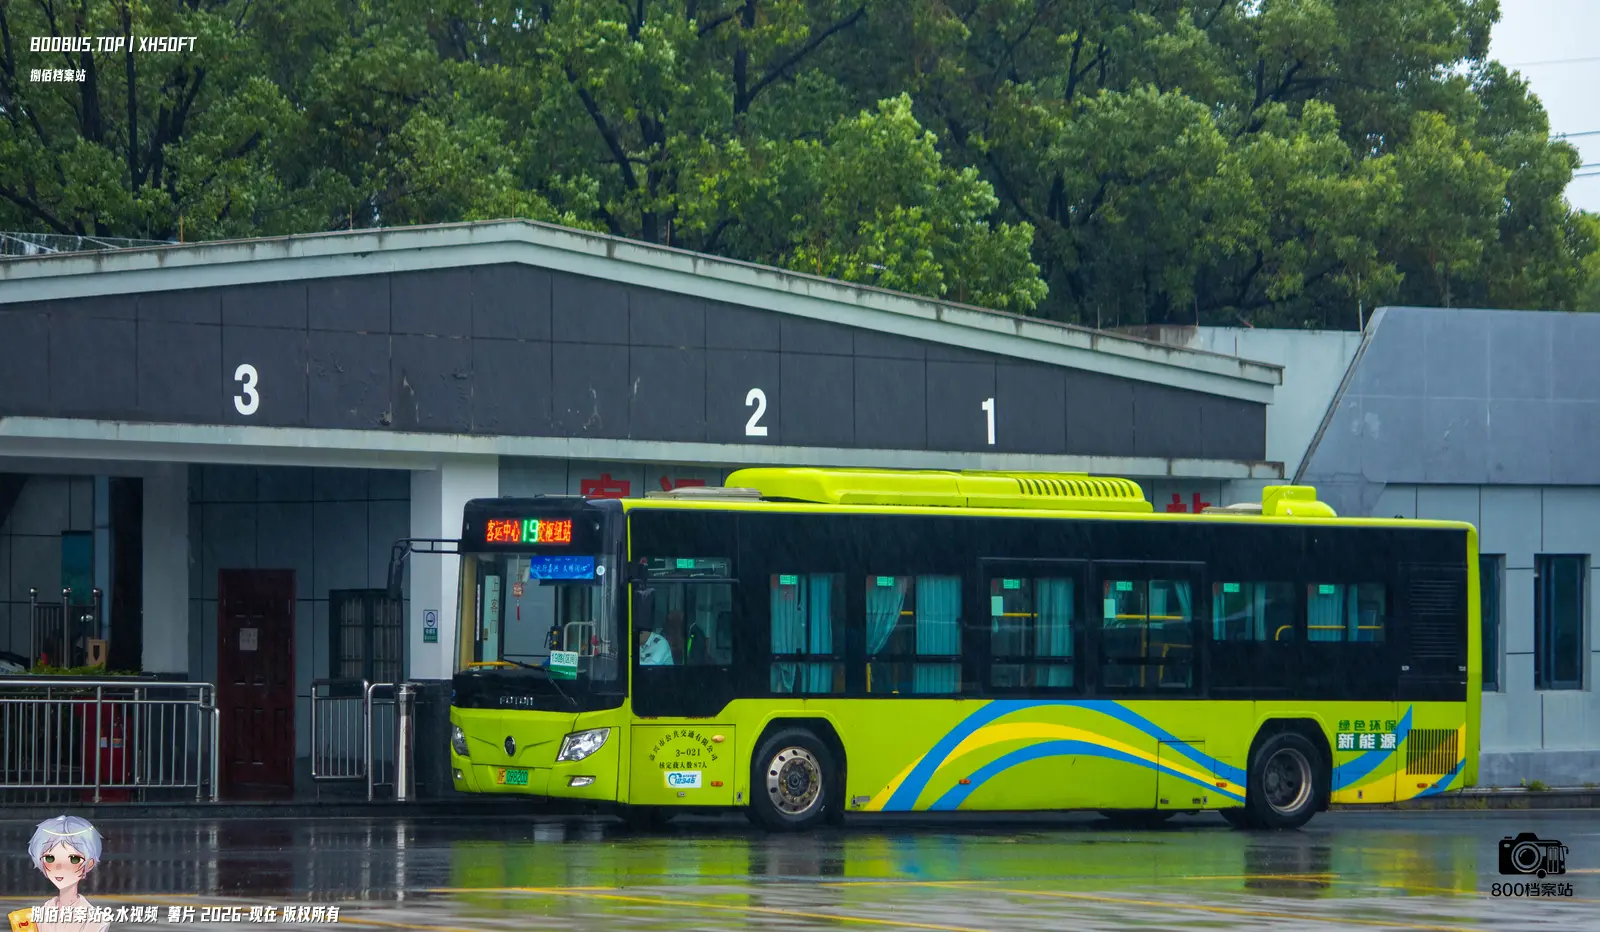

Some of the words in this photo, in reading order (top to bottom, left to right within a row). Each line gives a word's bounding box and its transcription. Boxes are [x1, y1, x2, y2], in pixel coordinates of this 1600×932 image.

[234, 364, 260, 415] 3
[745, 388, 768, 437] 2
[981, 397, 996, 445] 1
[486, 519, 521, 543] 客运中心
[522, 519, 539, 543] 19
[1338, 719, 1397, 731] 绿色环保
[649, 729, 719, 762] 嘉兴市公共交通有限公司
[675, 748, 701, 758] 3-021
[1338, 733, 1396, 749] 新能源
